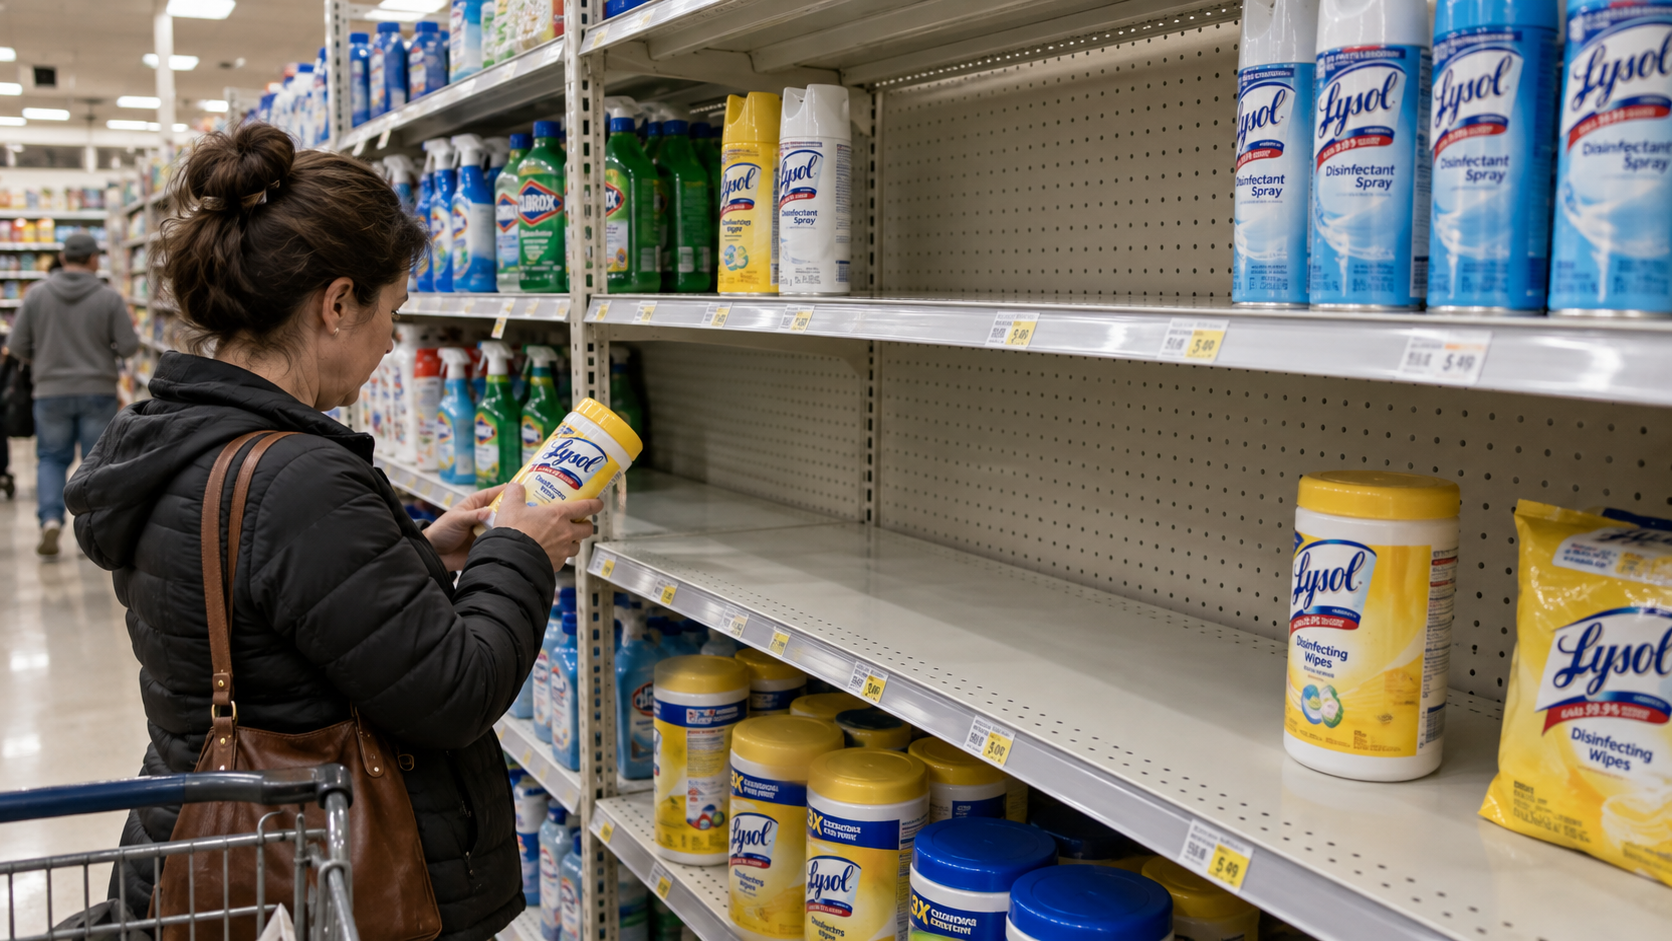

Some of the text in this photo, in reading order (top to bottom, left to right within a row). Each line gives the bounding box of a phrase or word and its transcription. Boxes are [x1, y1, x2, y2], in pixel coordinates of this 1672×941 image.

[1318, 71, 1397, 139] Lysol
[1434, 55, 1513, 128] Lysol
[1325, 164, 1396, 177] Disinfectant
[1355, 176, 1393, 191] Spray
[1465, 169, 1507, 184] Spray
[1251, 186, 1283, 198] Spray
[793, 216, 816, 226] Spray
[542, 439, 604, 473] Lysol
[1292, 550, 1367, 609] Lysol
[1296, 634, 1348, 662] Disinfecting
[1304, 651, 1333, 668] Wipes
[1553, 621, 1672, 696] Lysol
[1571, 727, 1653, 764] Disinfecting
[1589, 748, 1631, 771] Wipes
[731, 817, 773, 853] Lysol
[807, 808, 824, 836] 3X
[807, 860, 855, 899] Lysol
[911, 894, 931, 926] 3X
